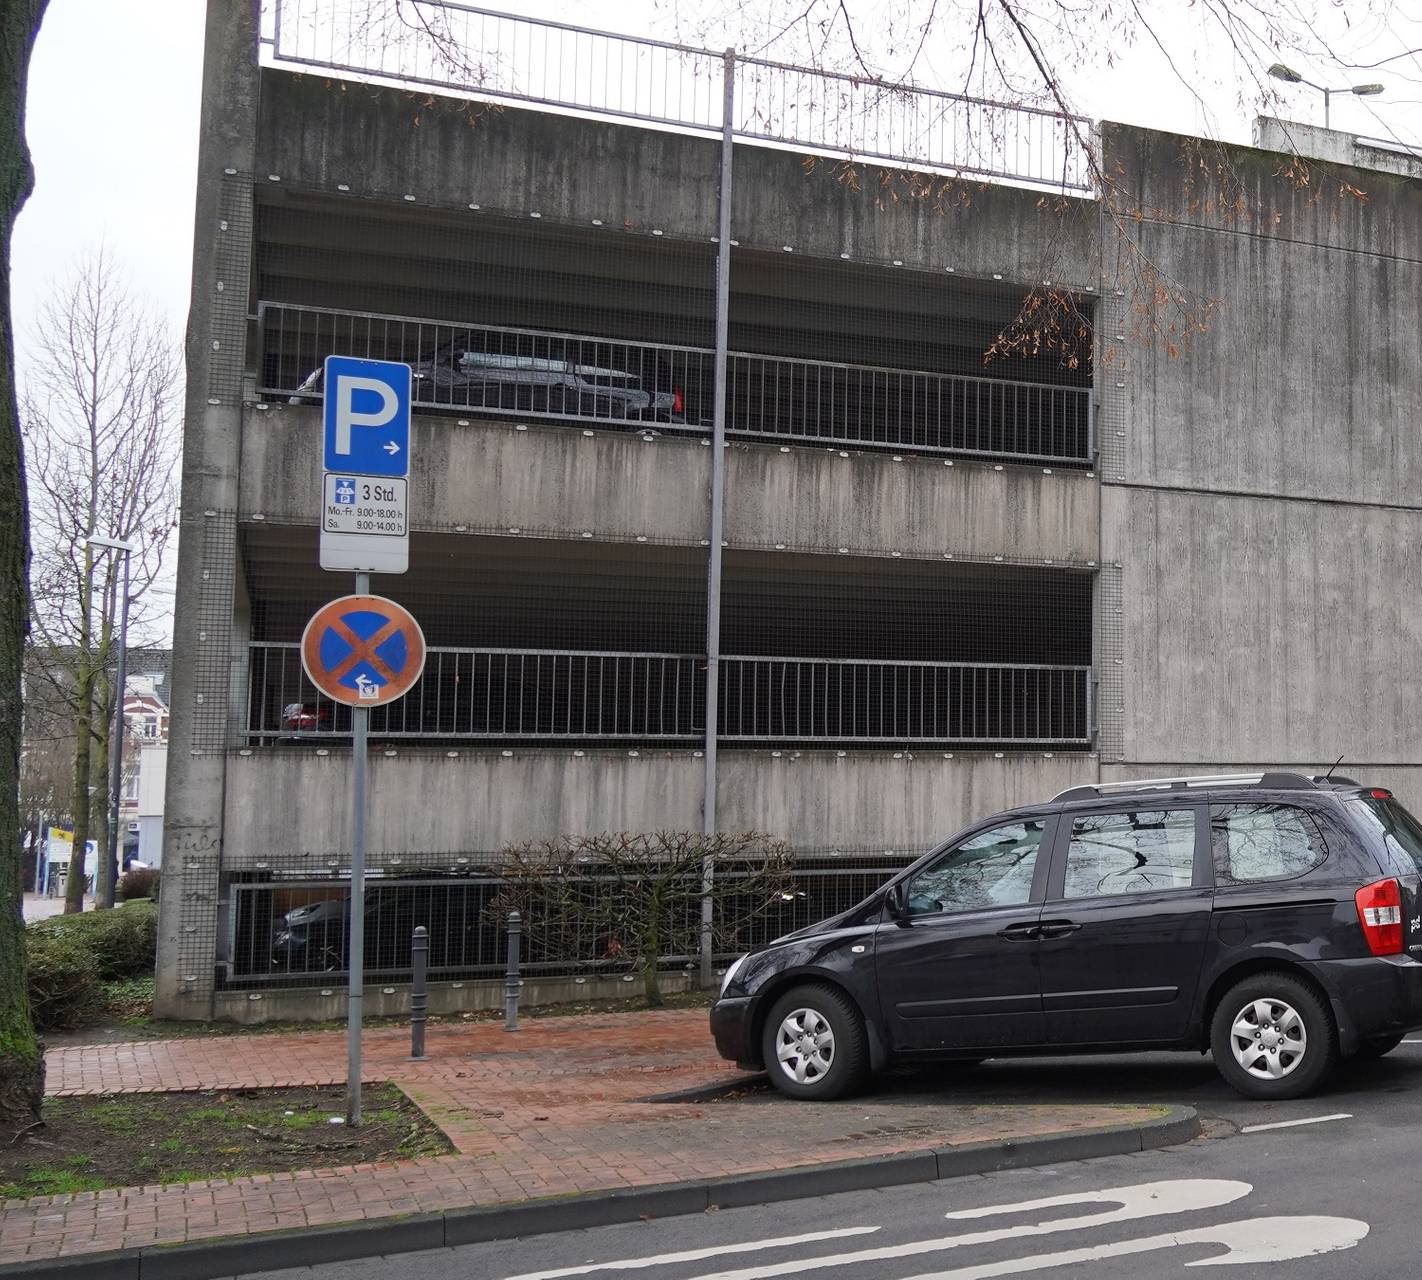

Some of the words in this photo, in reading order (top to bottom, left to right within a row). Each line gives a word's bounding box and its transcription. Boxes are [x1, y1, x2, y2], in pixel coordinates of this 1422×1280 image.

[335, 374, 399, 456] P
[362, 484, 371, 500] 3
[374, 485, 397, 502] Std.
[357, 507, 396, 519] 9.00-18.00
[397, 511, 403, 519] h
[328, 518, 340, 528] Sa.
[357, 520, 396, 532] 9.00-14.00
[397, 523, 403, 532] h
